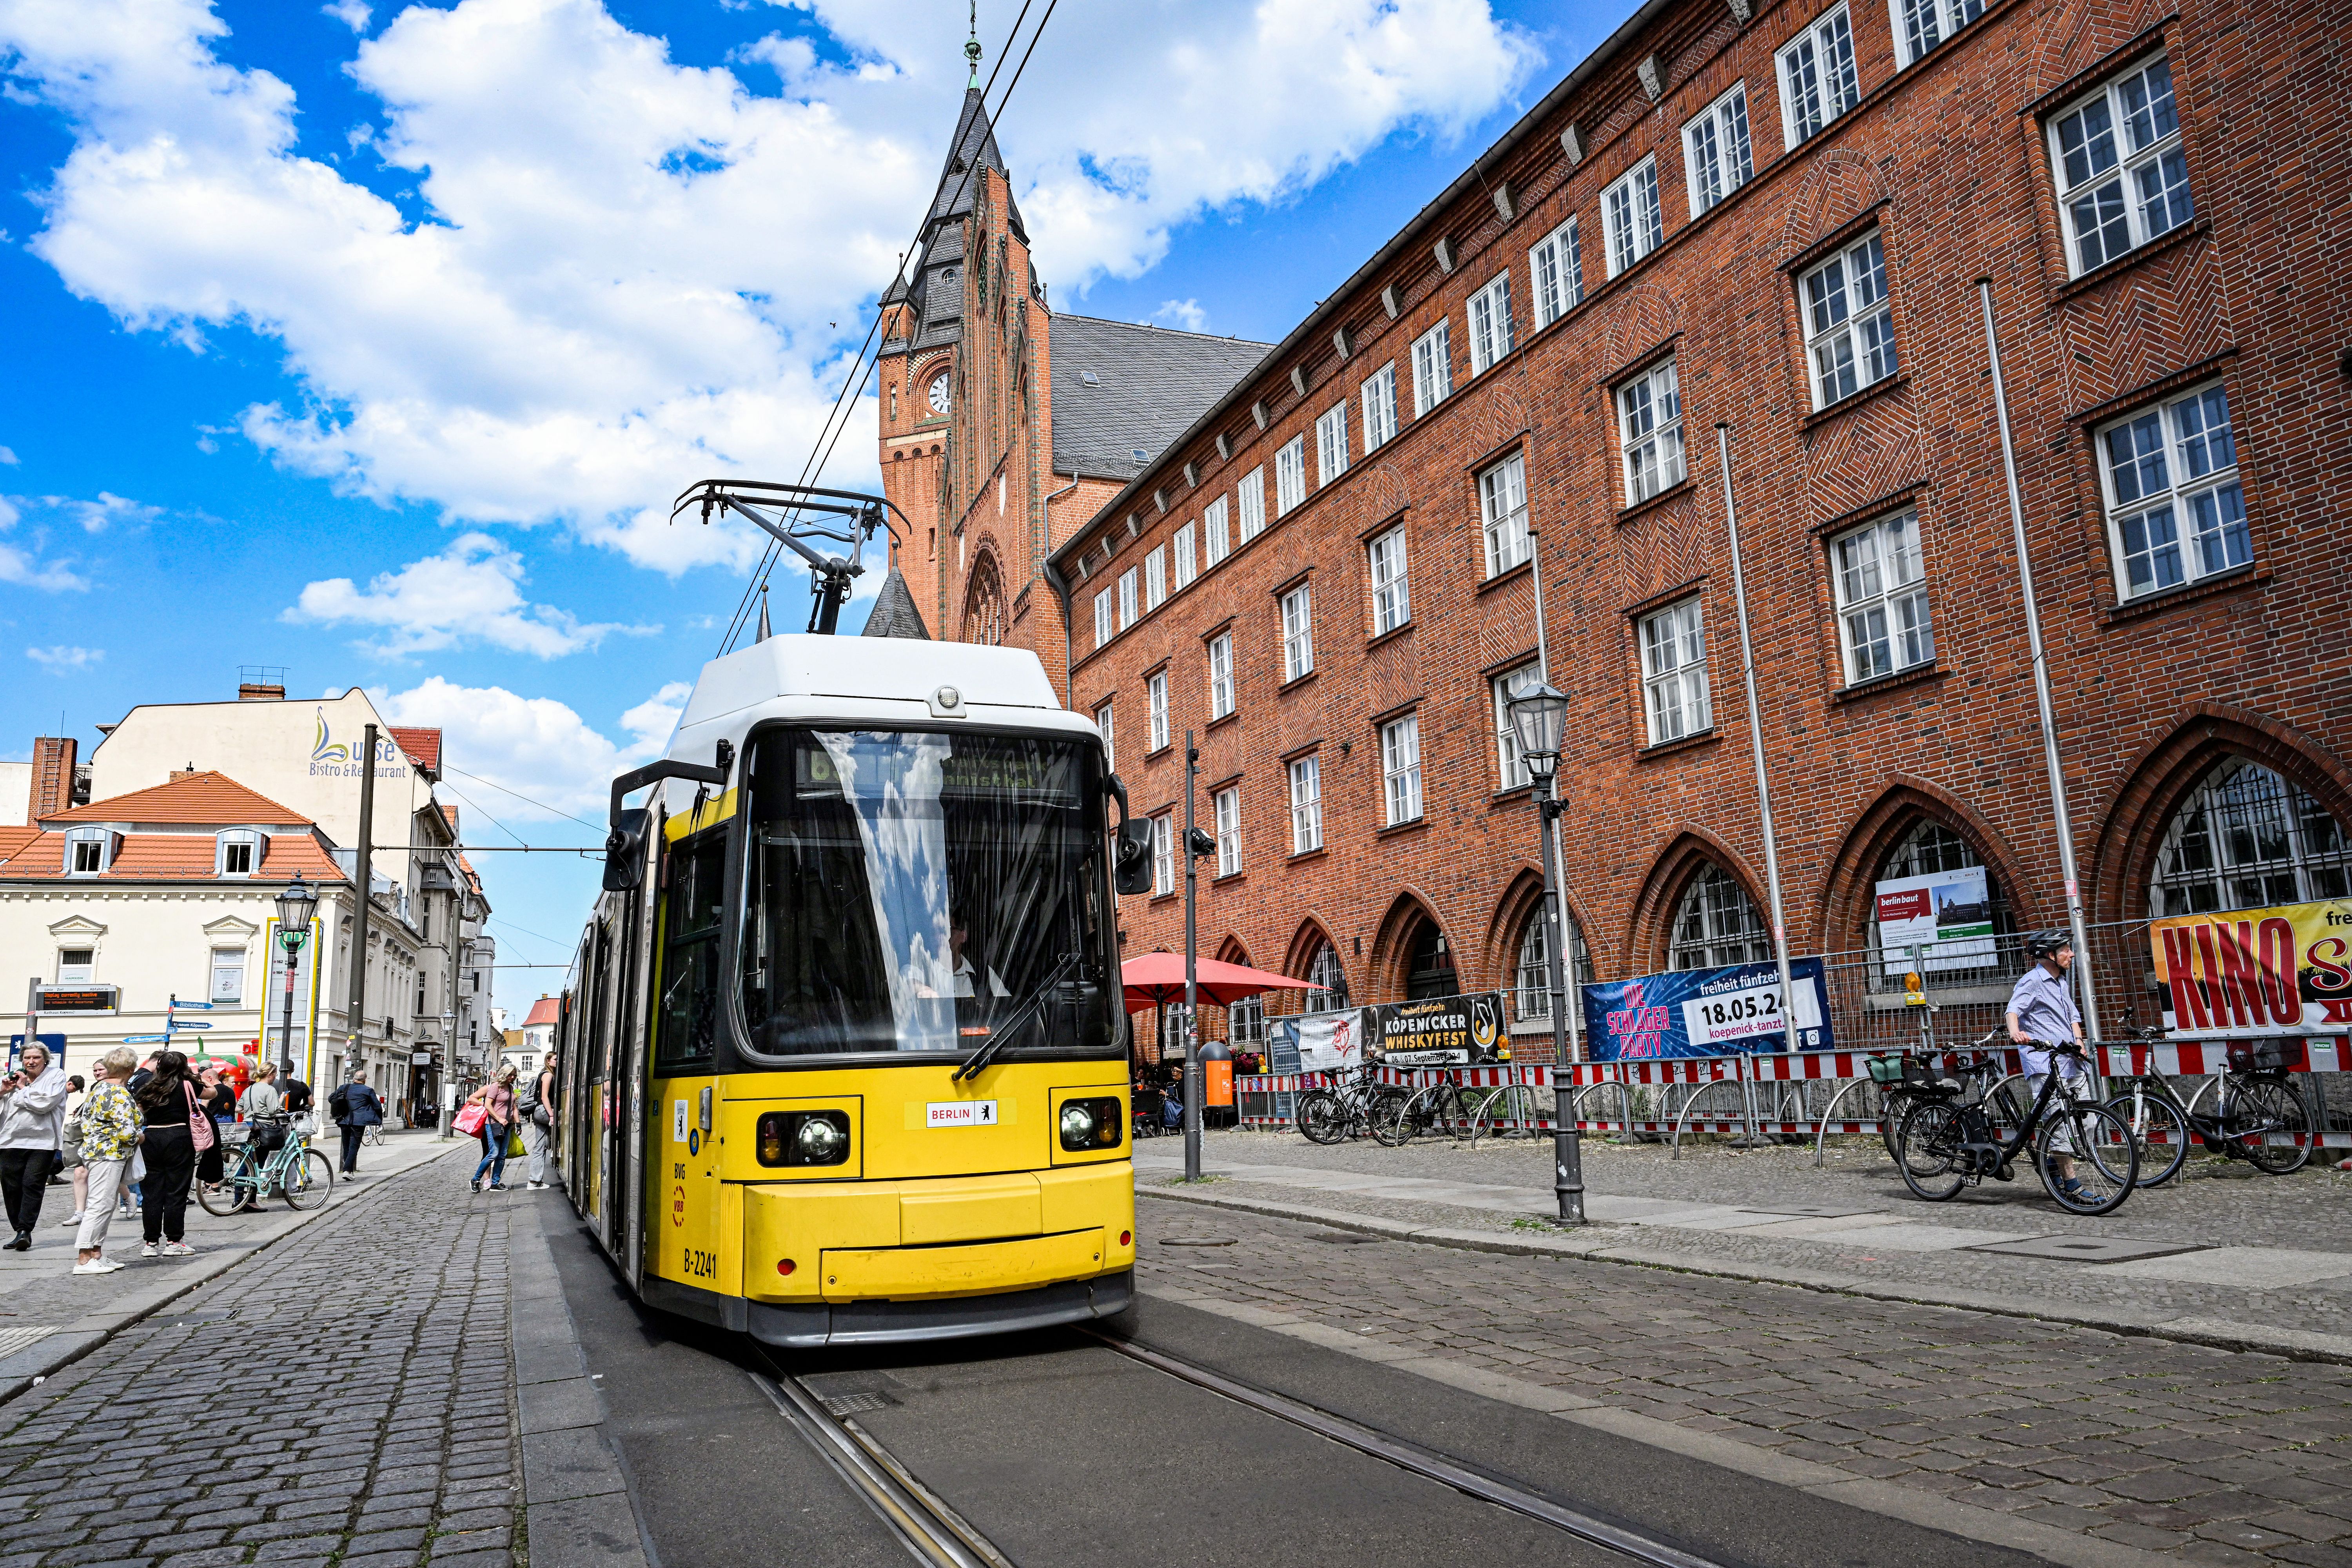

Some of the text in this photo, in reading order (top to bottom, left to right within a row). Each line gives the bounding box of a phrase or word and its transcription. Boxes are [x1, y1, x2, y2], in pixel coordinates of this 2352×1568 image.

[309, 762, 406, 778] Bistro & Reaurant
[1881, 894, 1918, 906] berlin baut
[2326, 910, 2352, 926] fre
[2306, 937, 2352, 991] S
[2160, 916, 2303, 1031] KINO
[1700, 969, 1780, 996] freiheit fünfzeh
[1623, 984, 1646, 1009] DIE
[1400, 1002, 1445, 1015] freiheit fünfzehn
[1385, 1014, 1466, 1034] KÖPENICKER
[1606, 1005, 1671, 1035] SCHLAGER
[1385, 1031, 1466, 1049] WHISKYFEST
[1620, 1032, 1661, 1058] PARTY
[1392, 1055, 1400, 1063] 06.
[1400, 1055, 1405, 1063] &
[1476, 1054, 1499, 1063] SEIT 2013
[932, 1109, 969, 1120] BERLIN
[674, 1163, 686, 1180] BVG
[674, 1200, 684, 1212] VBB
[684, 1248, 716, 1279] B-2241
